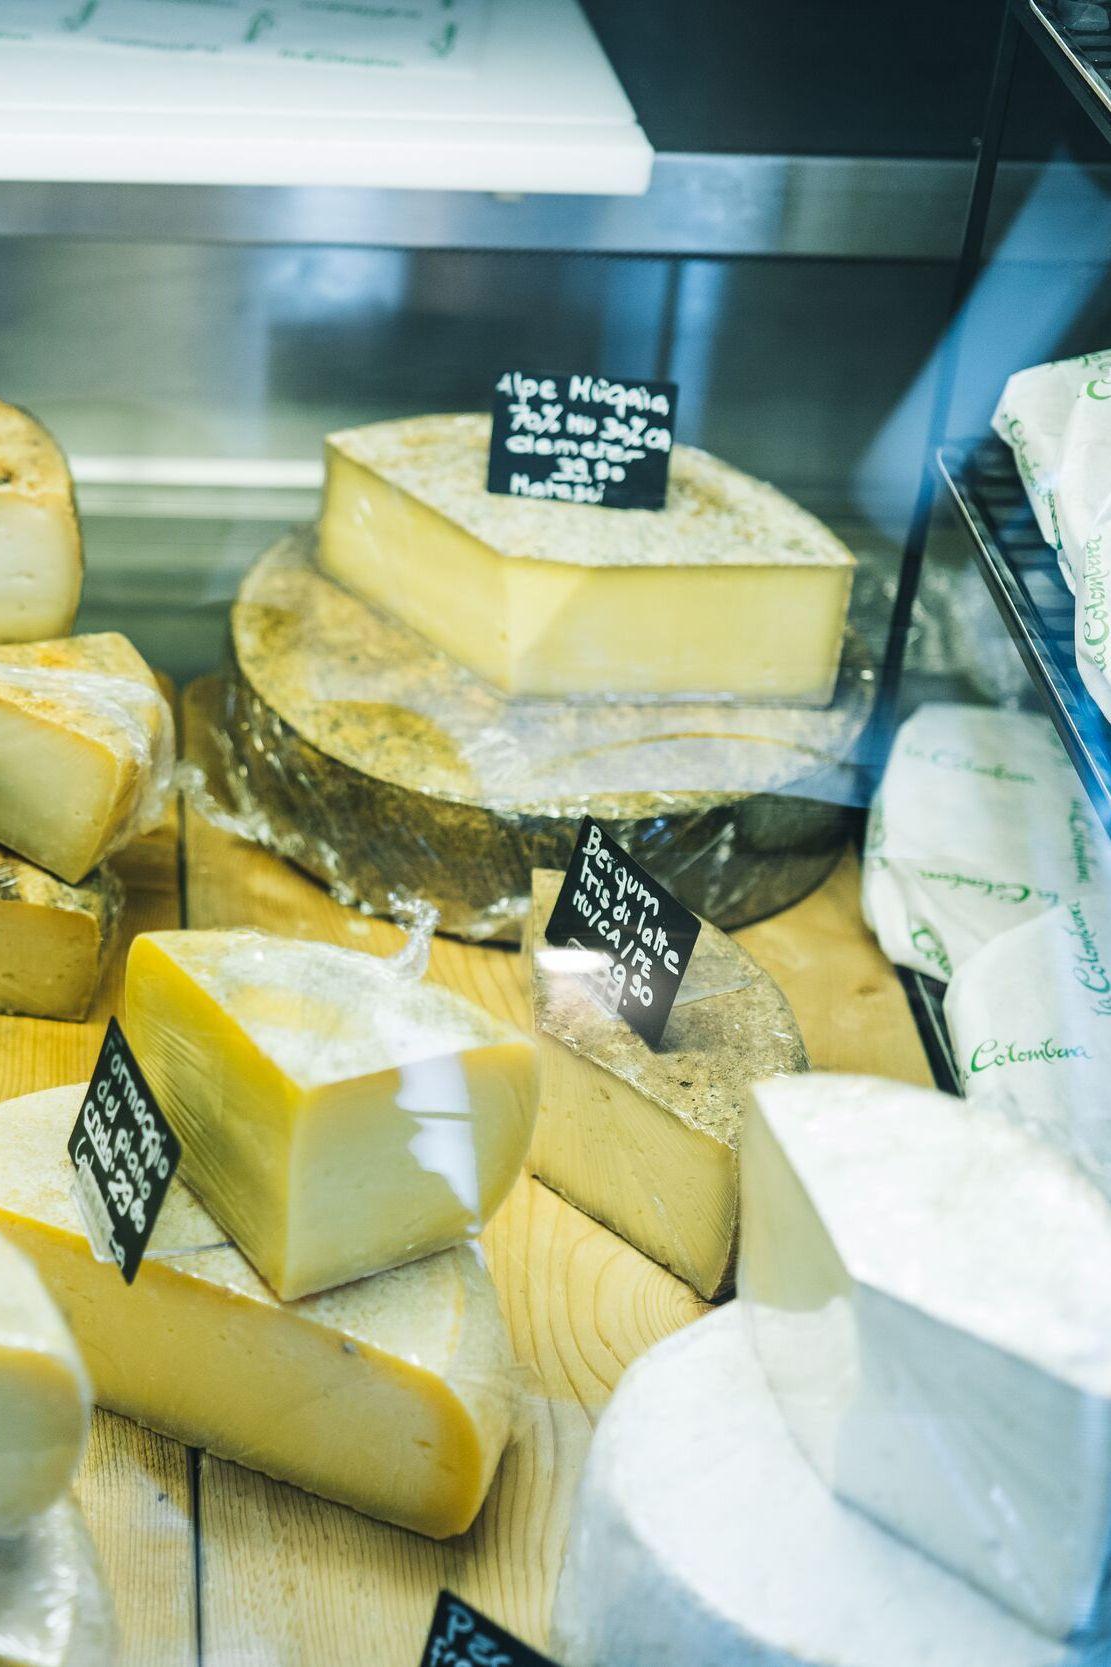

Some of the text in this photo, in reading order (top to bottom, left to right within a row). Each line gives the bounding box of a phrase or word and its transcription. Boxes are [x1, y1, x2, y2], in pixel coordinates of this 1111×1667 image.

[495, 371, 558, 404] Alpe
[612, 901, 631, 926] di
[636, 911, 680, 976] latte
[97, 1079, 121, 1123] del
